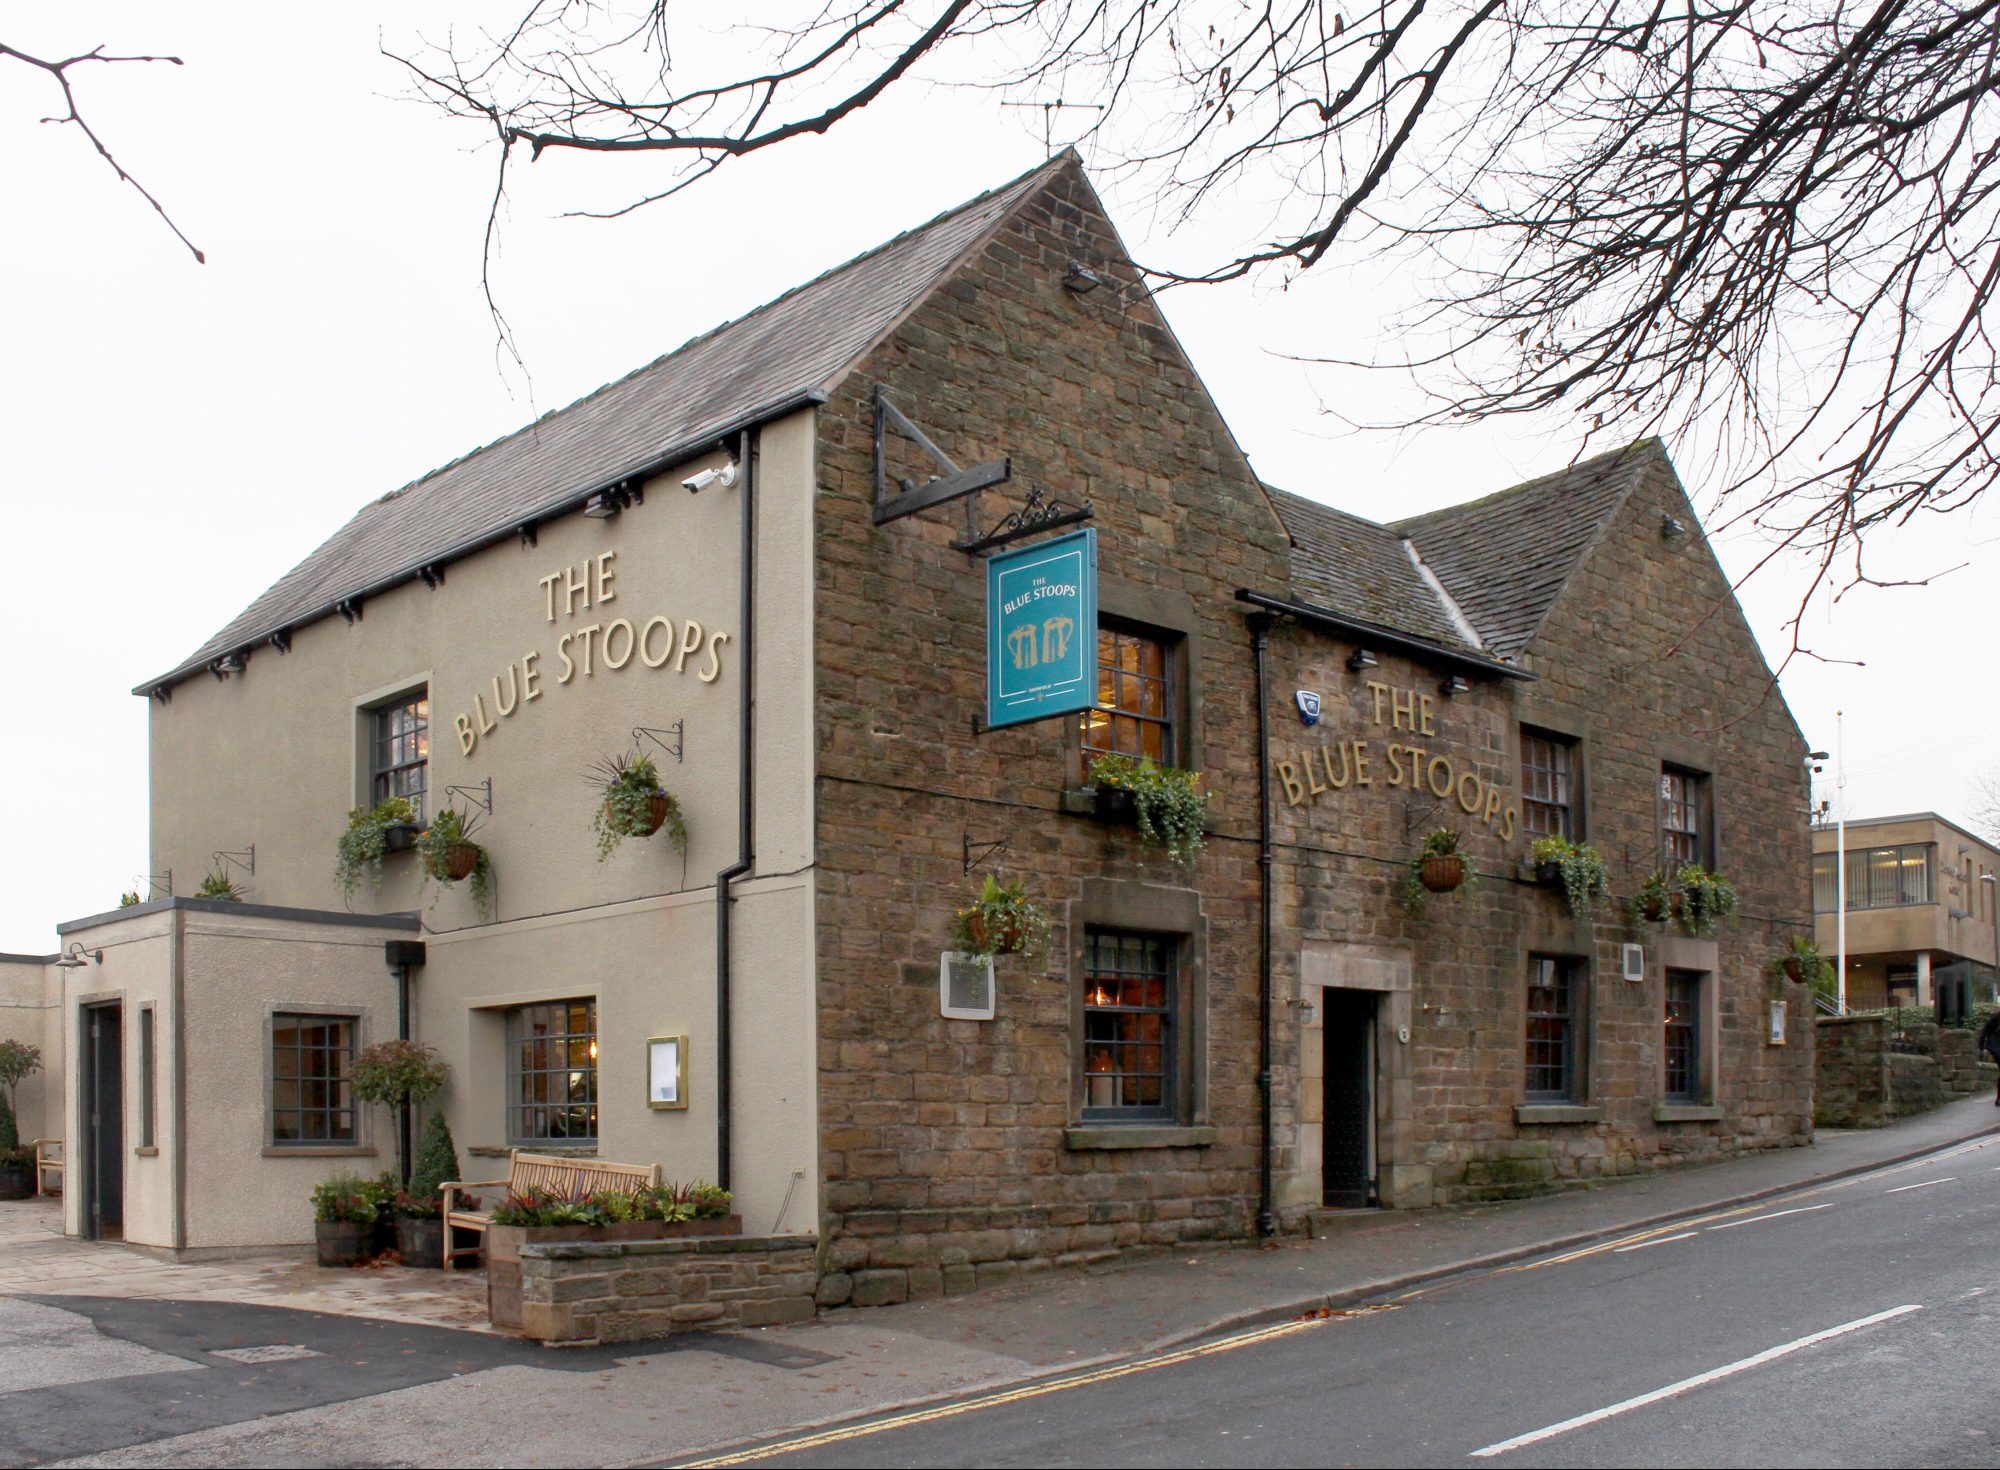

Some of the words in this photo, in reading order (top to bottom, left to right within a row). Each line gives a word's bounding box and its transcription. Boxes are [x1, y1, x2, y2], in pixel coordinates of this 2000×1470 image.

[539, 550, 616, 622] THE
[1004, 592, 1031, 614] BLUE
[1034, 585, 1076, 600] STOOPS
[1032, 576, 1047, 586] THE
[454, 651, 542, 757] BLUE
[558, 616, 730, 682] STOOPS
[1367, 680, 1435, 736] THE
[1277, 741, 1373, 806] BLUE
[1387, 744, 1516, 841] STOOPS
